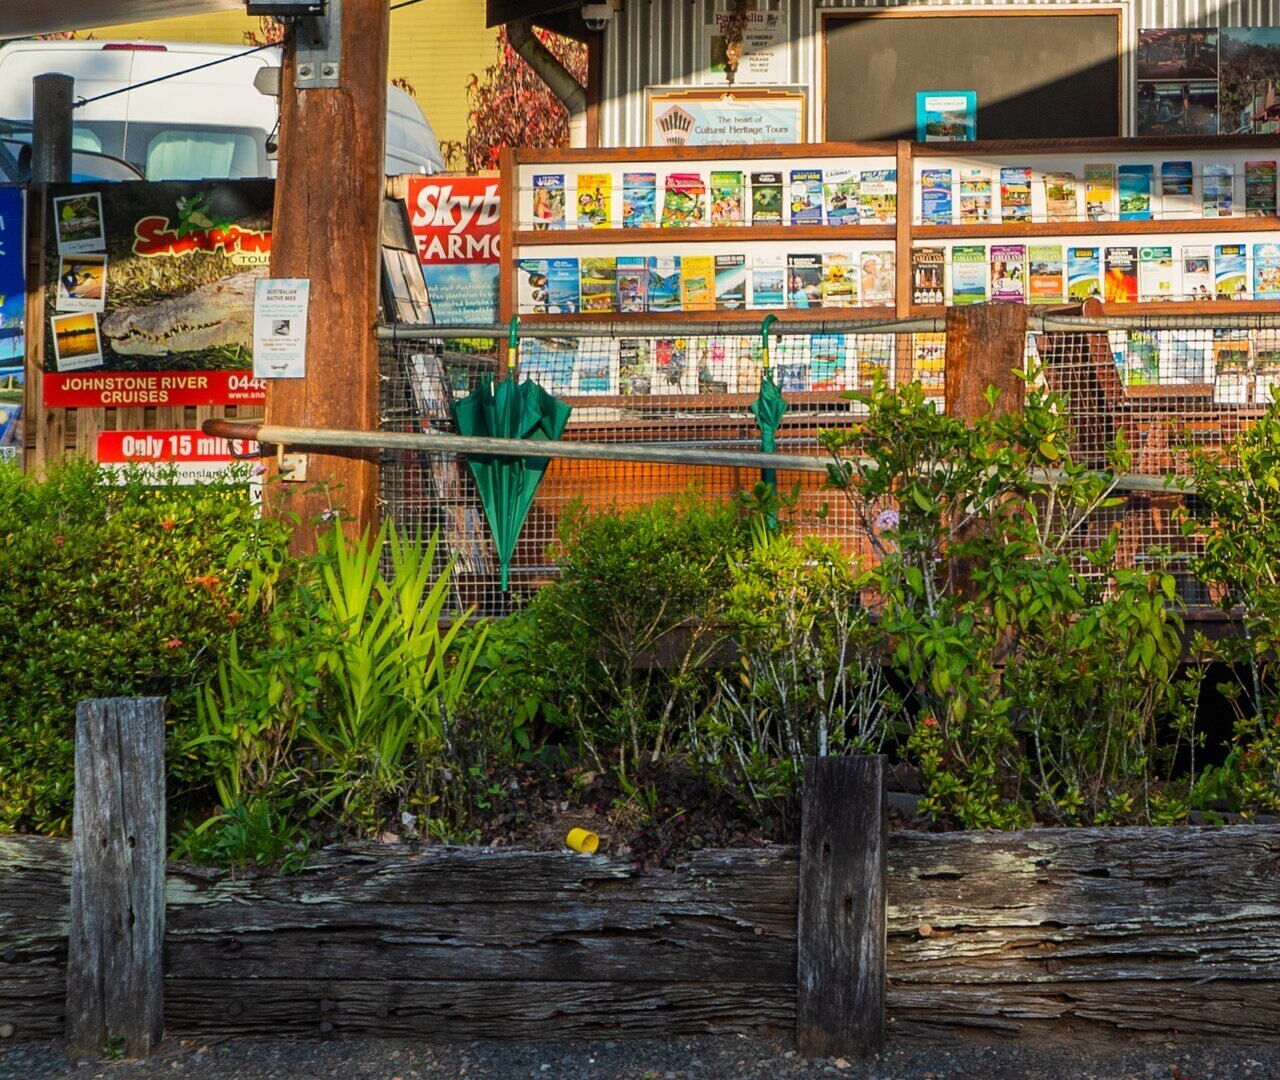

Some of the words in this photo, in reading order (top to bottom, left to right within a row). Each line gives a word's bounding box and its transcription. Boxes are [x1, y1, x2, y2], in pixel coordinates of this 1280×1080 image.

[695, 126, 726, 134] Cultural
[729, 126, 763, 135] Heritage
[765, 125, 788, 133] Tours
[61, 376, 157, 391] JOHNSTONE
[161, 376, 208, 390] RIVER
[100, 390, 170, 404] CRUISES
[122, 435, 164, 459] Only
[168, 435, 192, 456] 15
